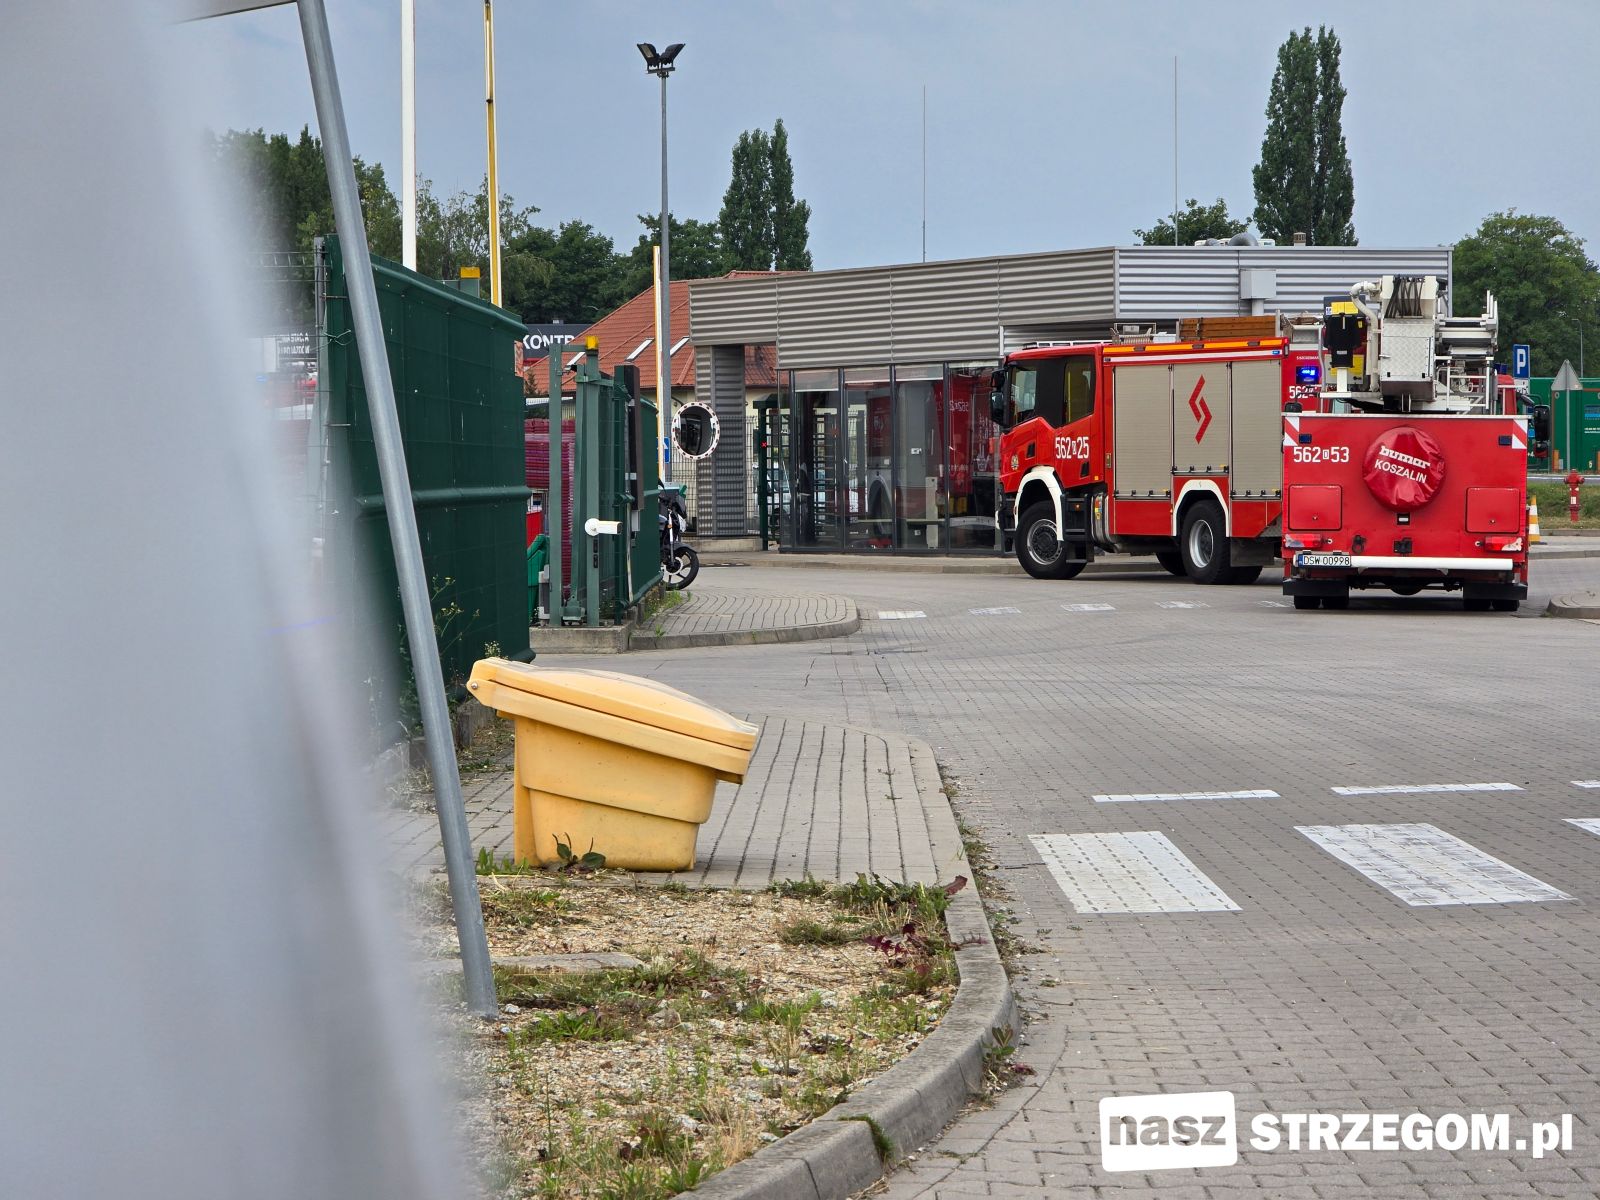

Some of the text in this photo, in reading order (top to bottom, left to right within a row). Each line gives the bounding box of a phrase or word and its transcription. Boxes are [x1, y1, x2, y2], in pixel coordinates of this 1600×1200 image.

[1516, 348, 1526, 374] P
[1374, 459, 1427, 484] KOSZALIN
[1303, 556, 1350, 566] DSW 00998
